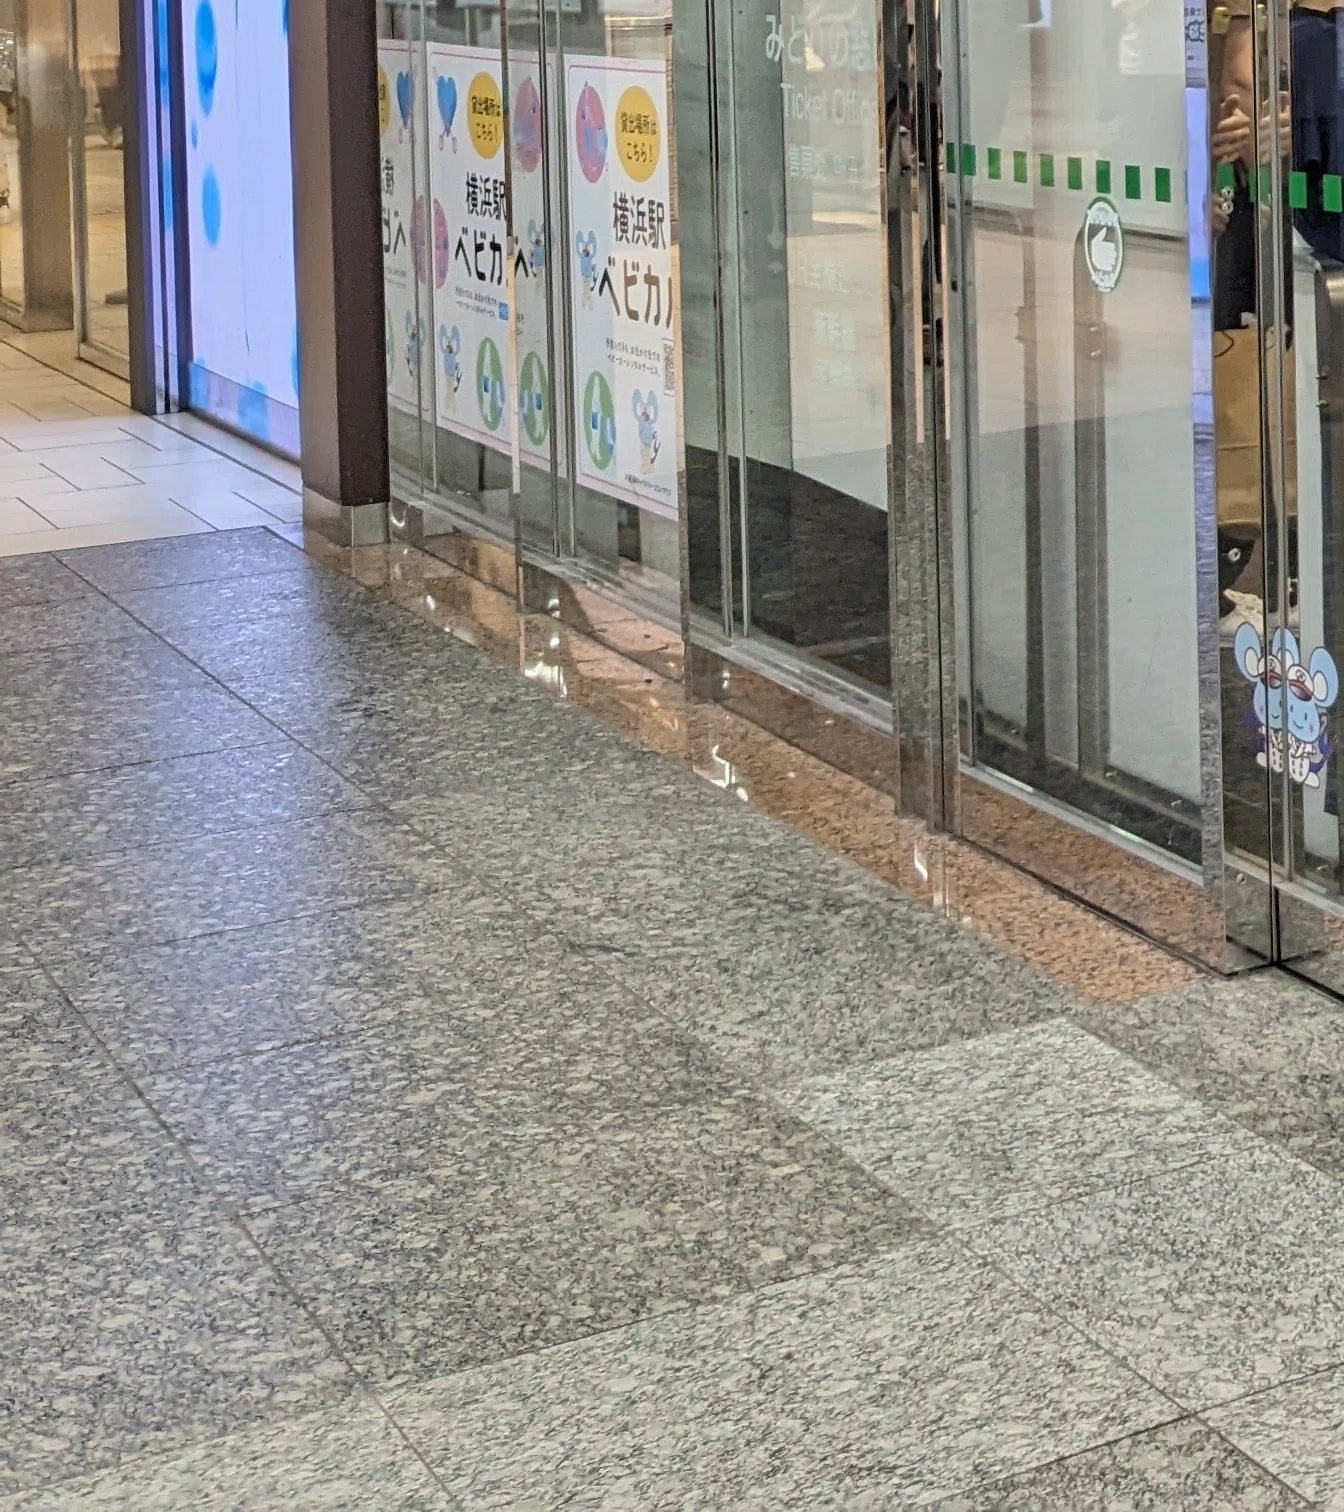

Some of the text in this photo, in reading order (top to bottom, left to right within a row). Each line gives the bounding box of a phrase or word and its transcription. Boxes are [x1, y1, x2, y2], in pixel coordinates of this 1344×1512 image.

[612, 191, 666, 250] 横浜駅
[455, 226, 508, 286] ベビカ
